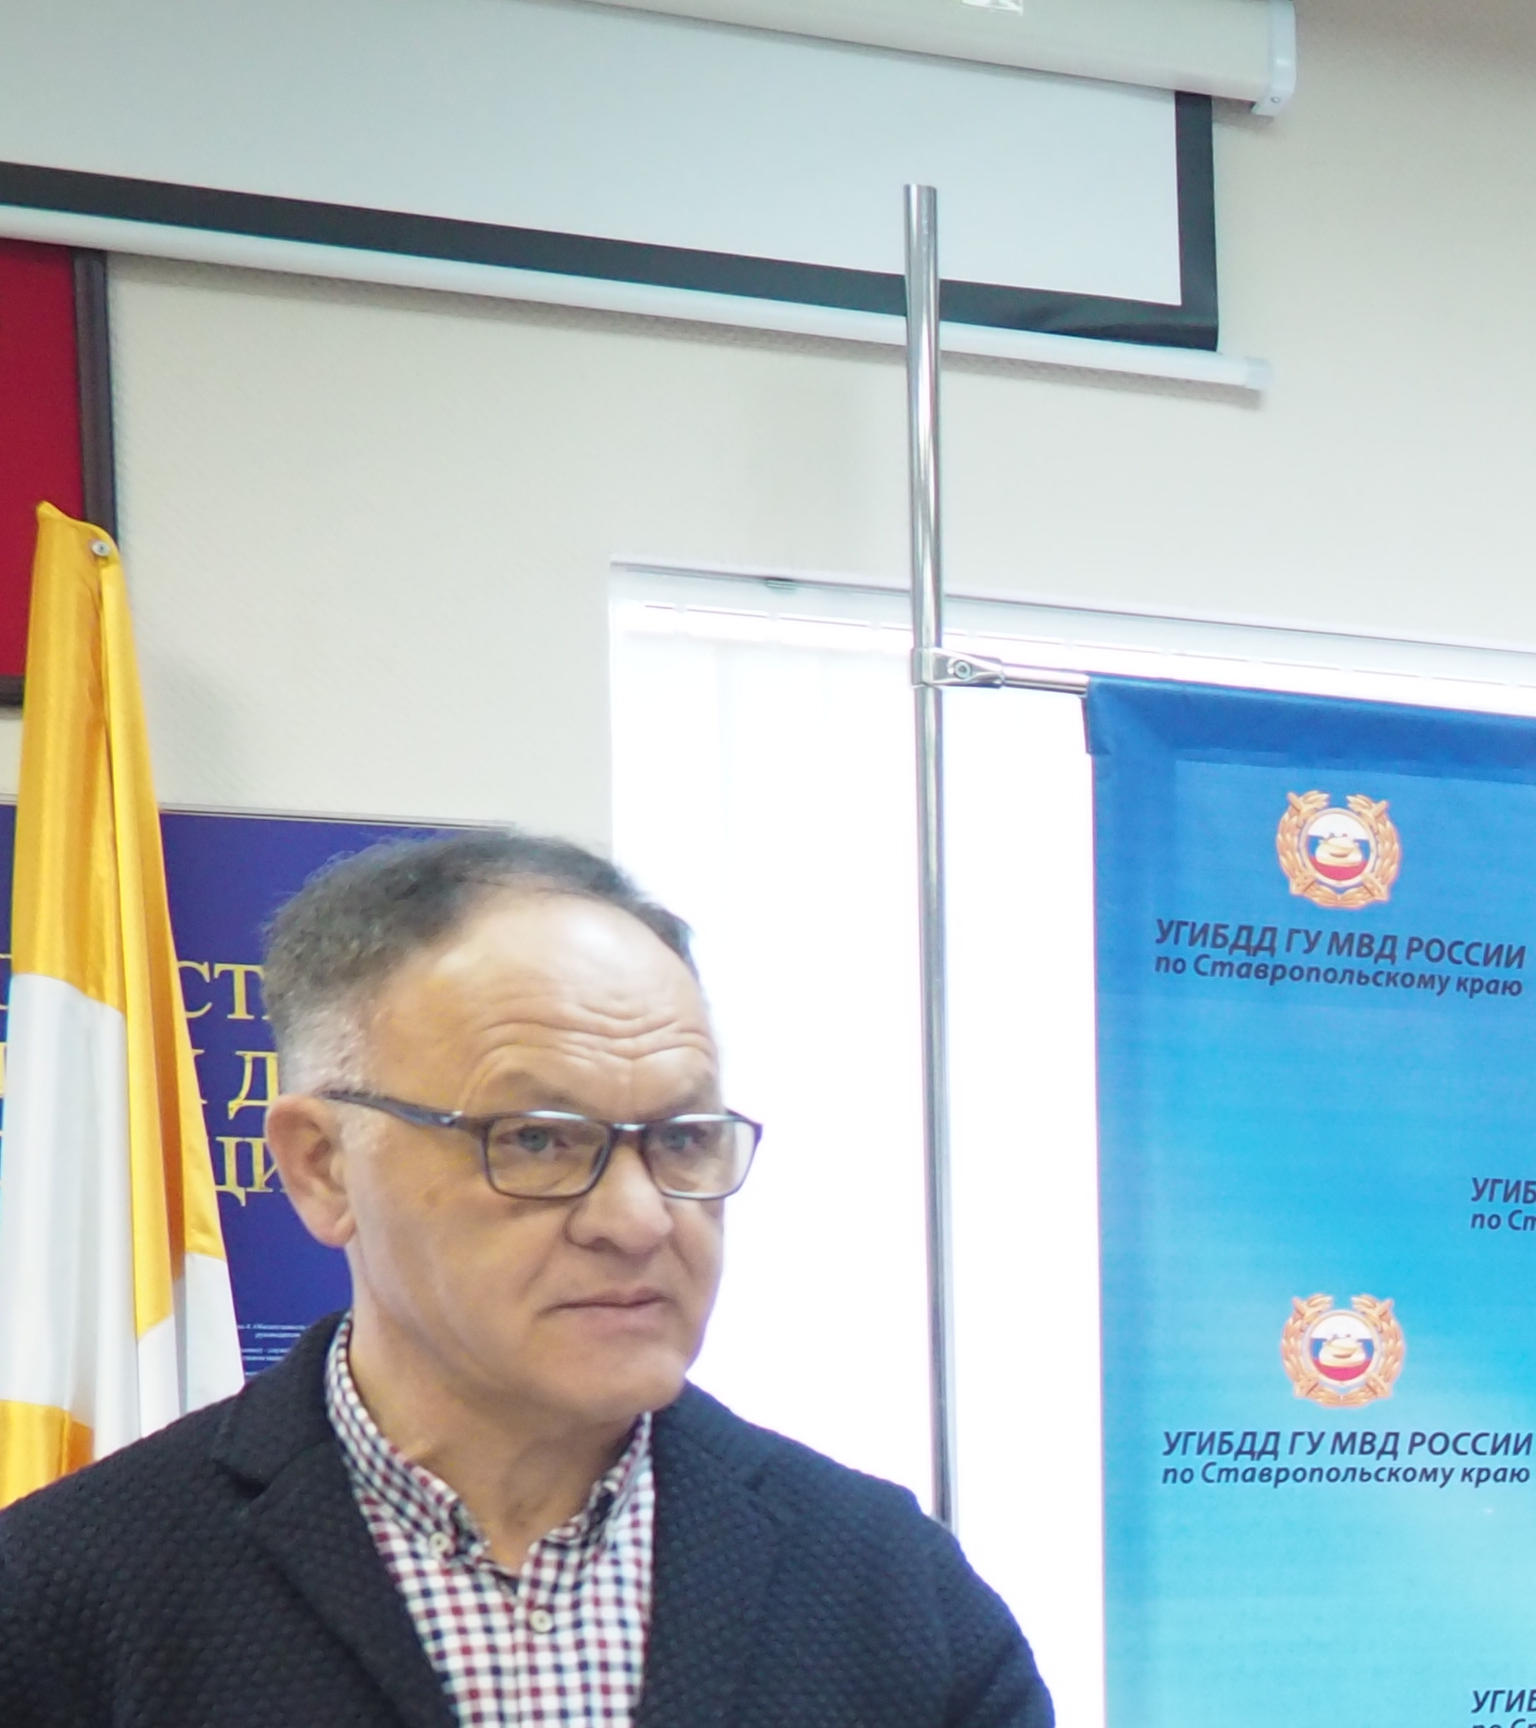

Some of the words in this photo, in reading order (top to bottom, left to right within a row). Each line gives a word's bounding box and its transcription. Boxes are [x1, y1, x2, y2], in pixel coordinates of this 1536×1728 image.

[1155, 919, 1277, 956] УГИБДД
[1286, 928, 1321, 957] ГУ
[1327, 931, 1397, 964] МВД
[1406, 935, 1527, 969] РОССИИ
[1154, 953, 1187, 975] по
[1193, 953, 1451, 996] Ставропольскому
[1456, 972, 1524, 999] краю
[1470, 1211, 1502, 1231] по
[1162, 1430, 1280, 1460] УГИБДД
[1288, 1430, 1324, 1457] ГУ
[1330, 1431, 1400, 1460] МВД
[1408, 1431, 1533, 1457] РОССИИ
[1162, 1465, 1195, 1484] по
[1201, 1461, 1455, 1488] Ставропольскому
[1460, 1463, 1531, 1488] краю
